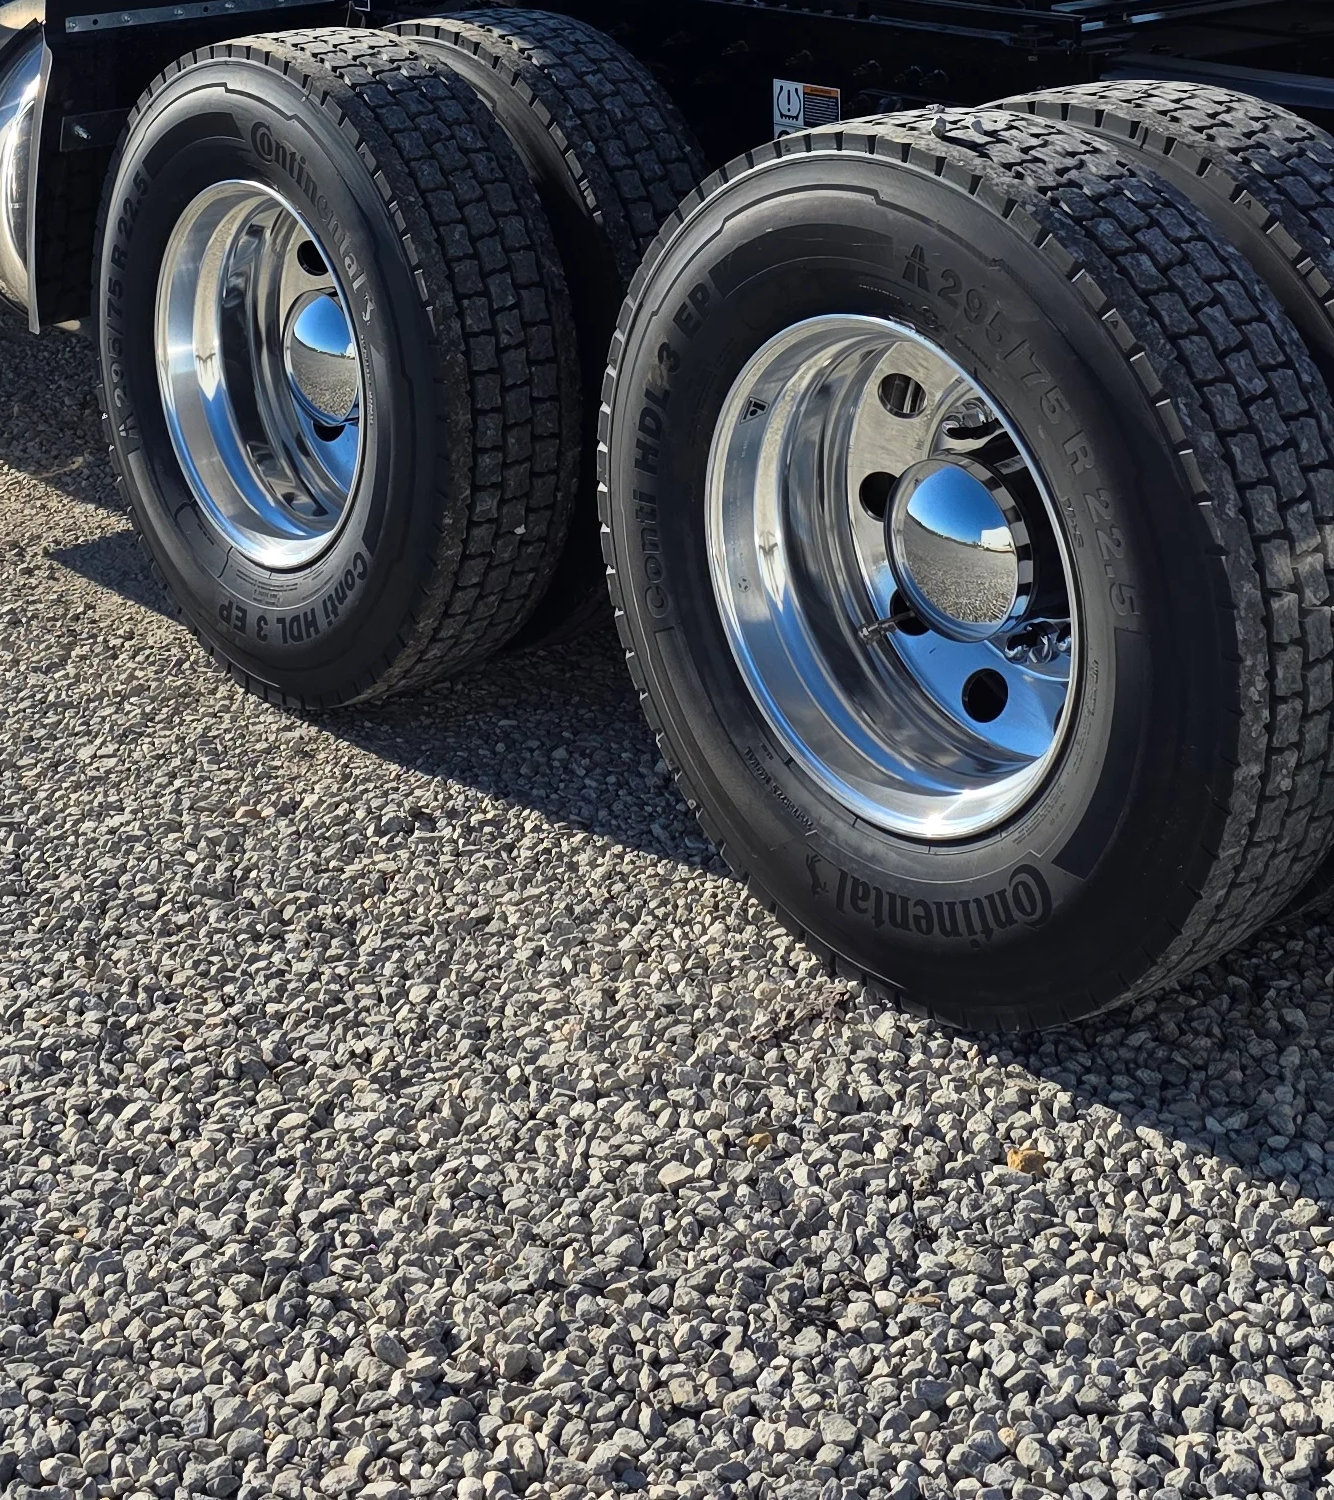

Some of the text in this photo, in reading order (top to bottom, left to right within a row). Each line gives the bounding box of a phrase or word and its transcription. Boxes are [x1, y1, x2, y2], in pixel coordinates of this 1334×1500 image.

[250, 121, 367, 291] Continental
[106, 170, 149, 408] 295/75 R 22.5
[632, 281, 715, 619] Conti HDL 3 EP
[936, 268, 1065, 425] 295/75
[1063, 430, 1095, 477] R
[1083, 486, 1140, 618] 22.5
[218, 600, 248, 636] EP
[256, 615, 269, 643] 3
[276, 608, 321, 644] HDL
[322, 551, 368, 627] Conti
[835, 863, 1054, 950] Continental
